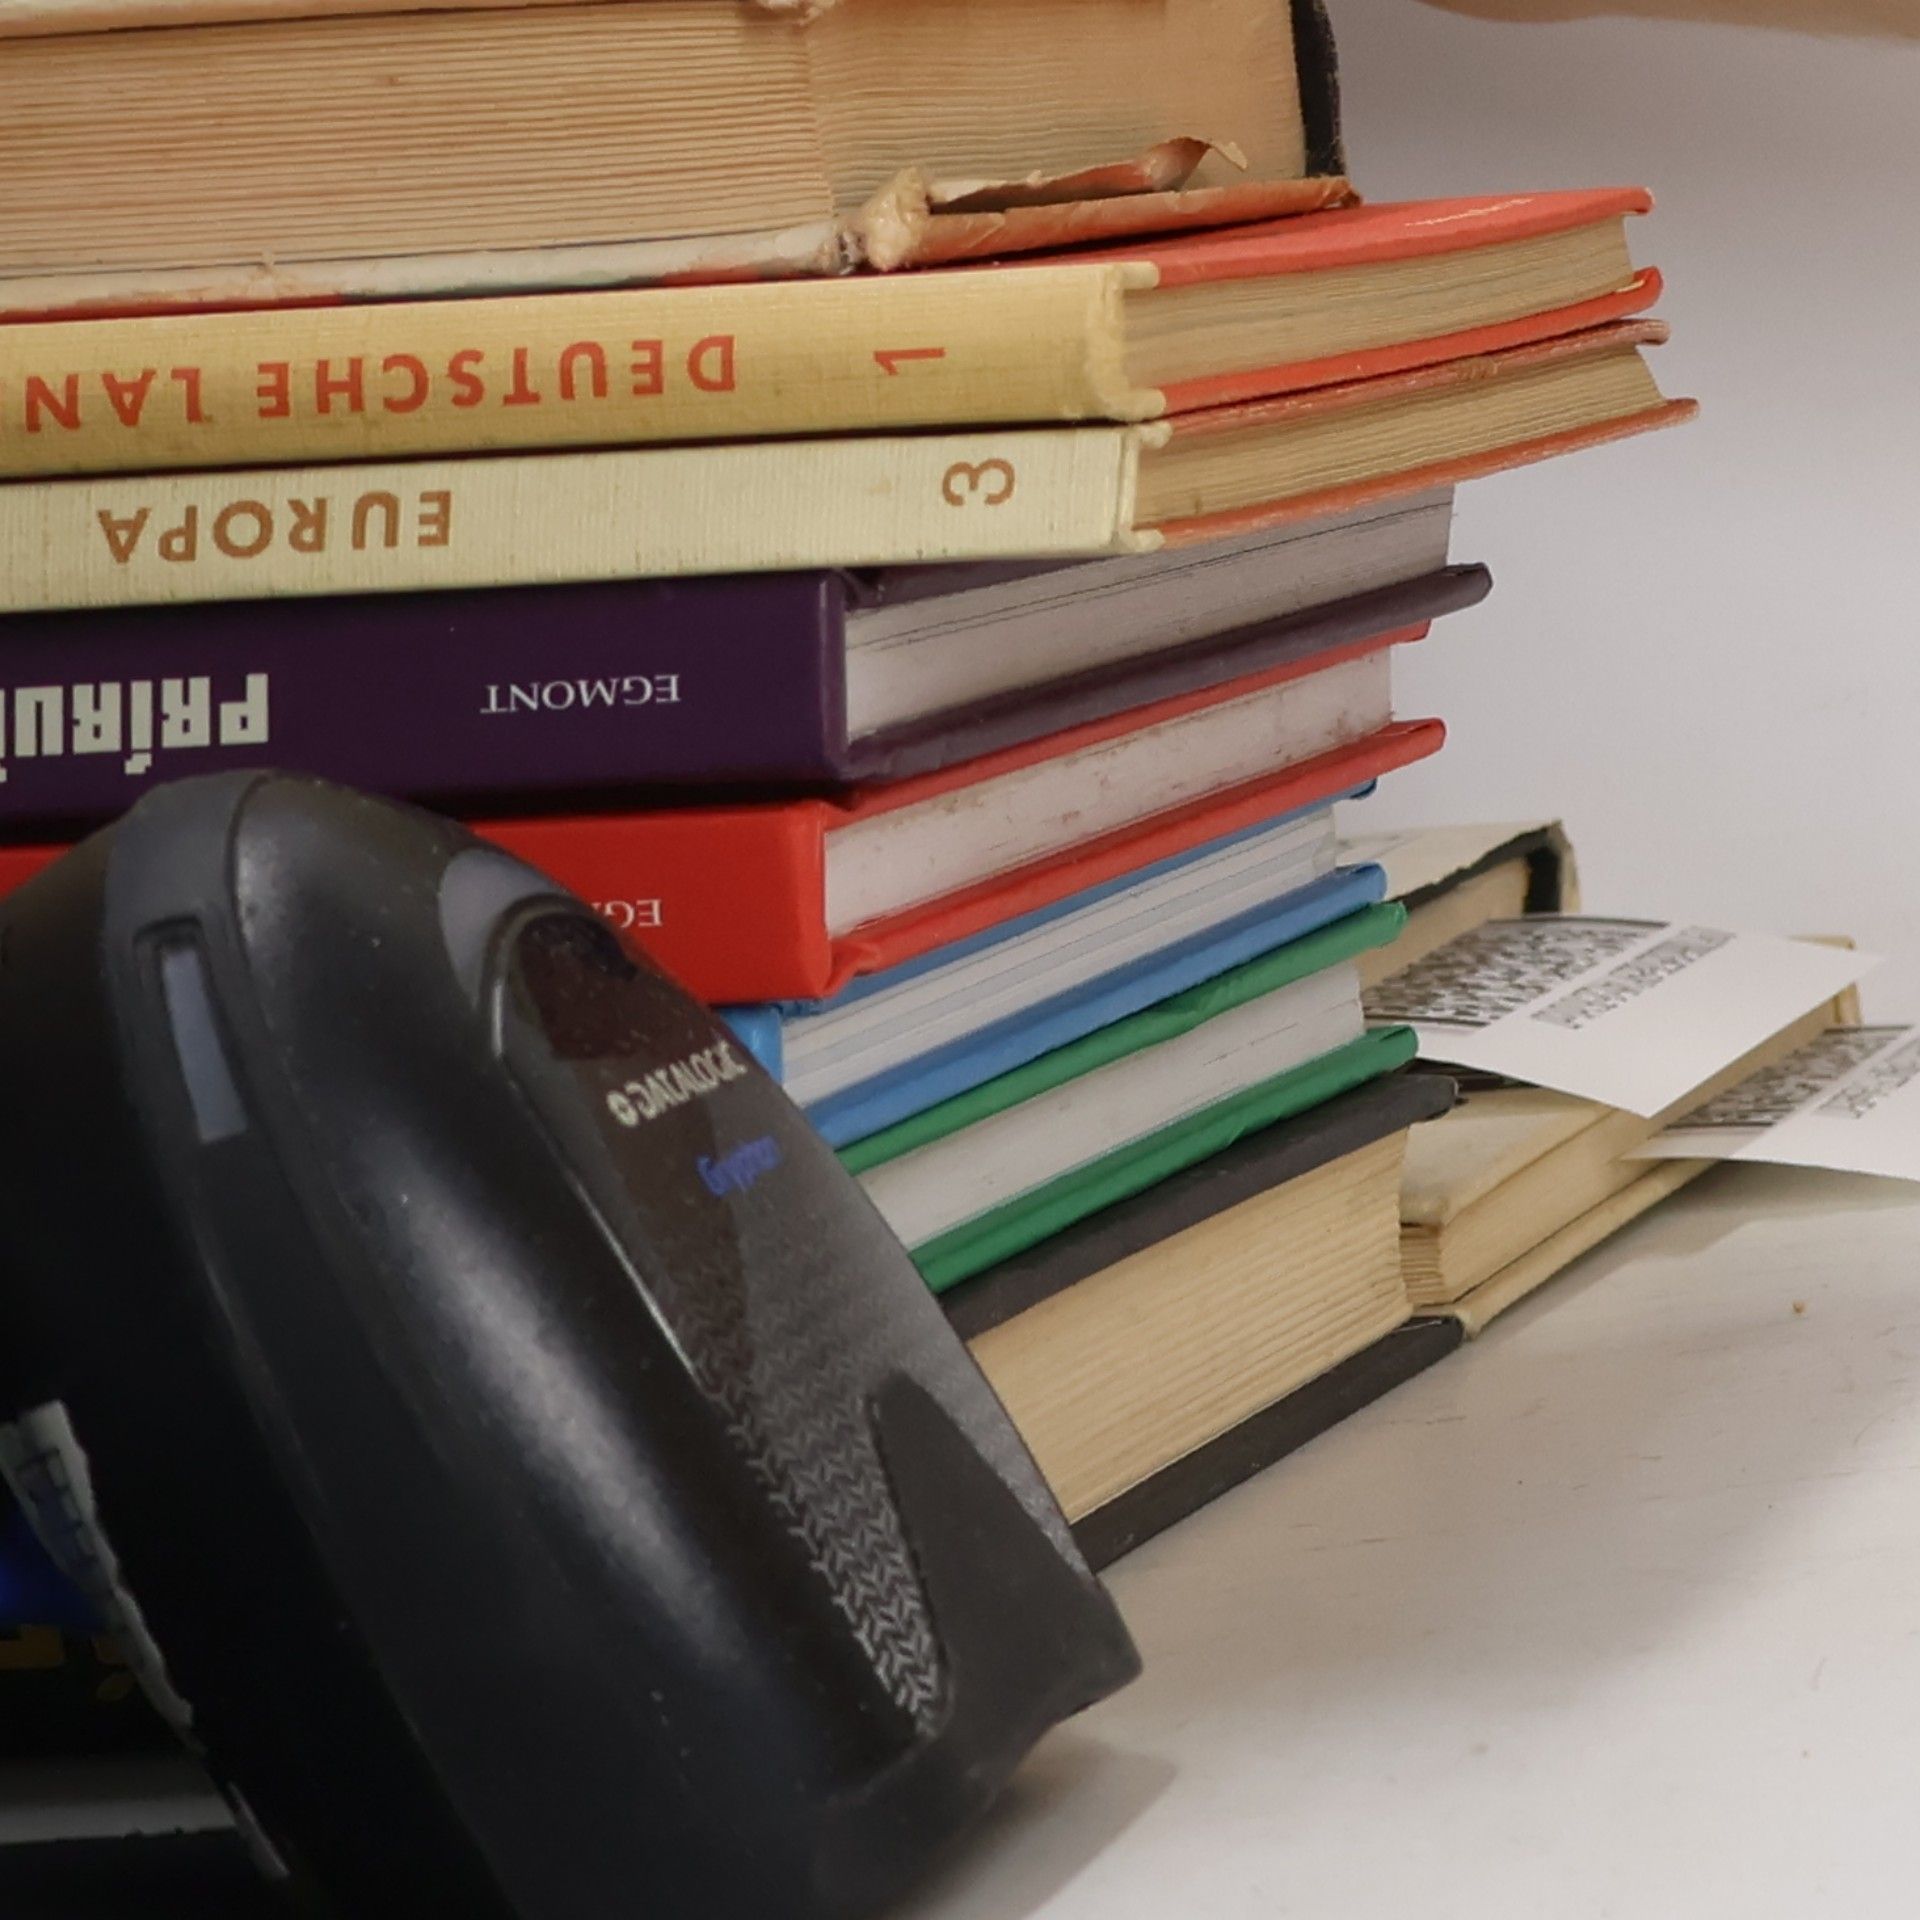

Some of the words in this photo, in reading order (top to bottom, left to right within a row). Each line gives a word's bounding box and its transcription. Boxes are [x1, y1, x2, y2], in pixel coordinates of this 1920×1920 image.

[257, 335, 736, 418] DEUTSCHE
[873, 347, 946, 376] 1
[942, 457, 1016, 507] 3
[97, 489, 452, 564] EUROPA
[480, 674, 680, 713] EGMONT
[0, 673, 268, 783] PRÍRU
[590, 899, 662, 928] EG
